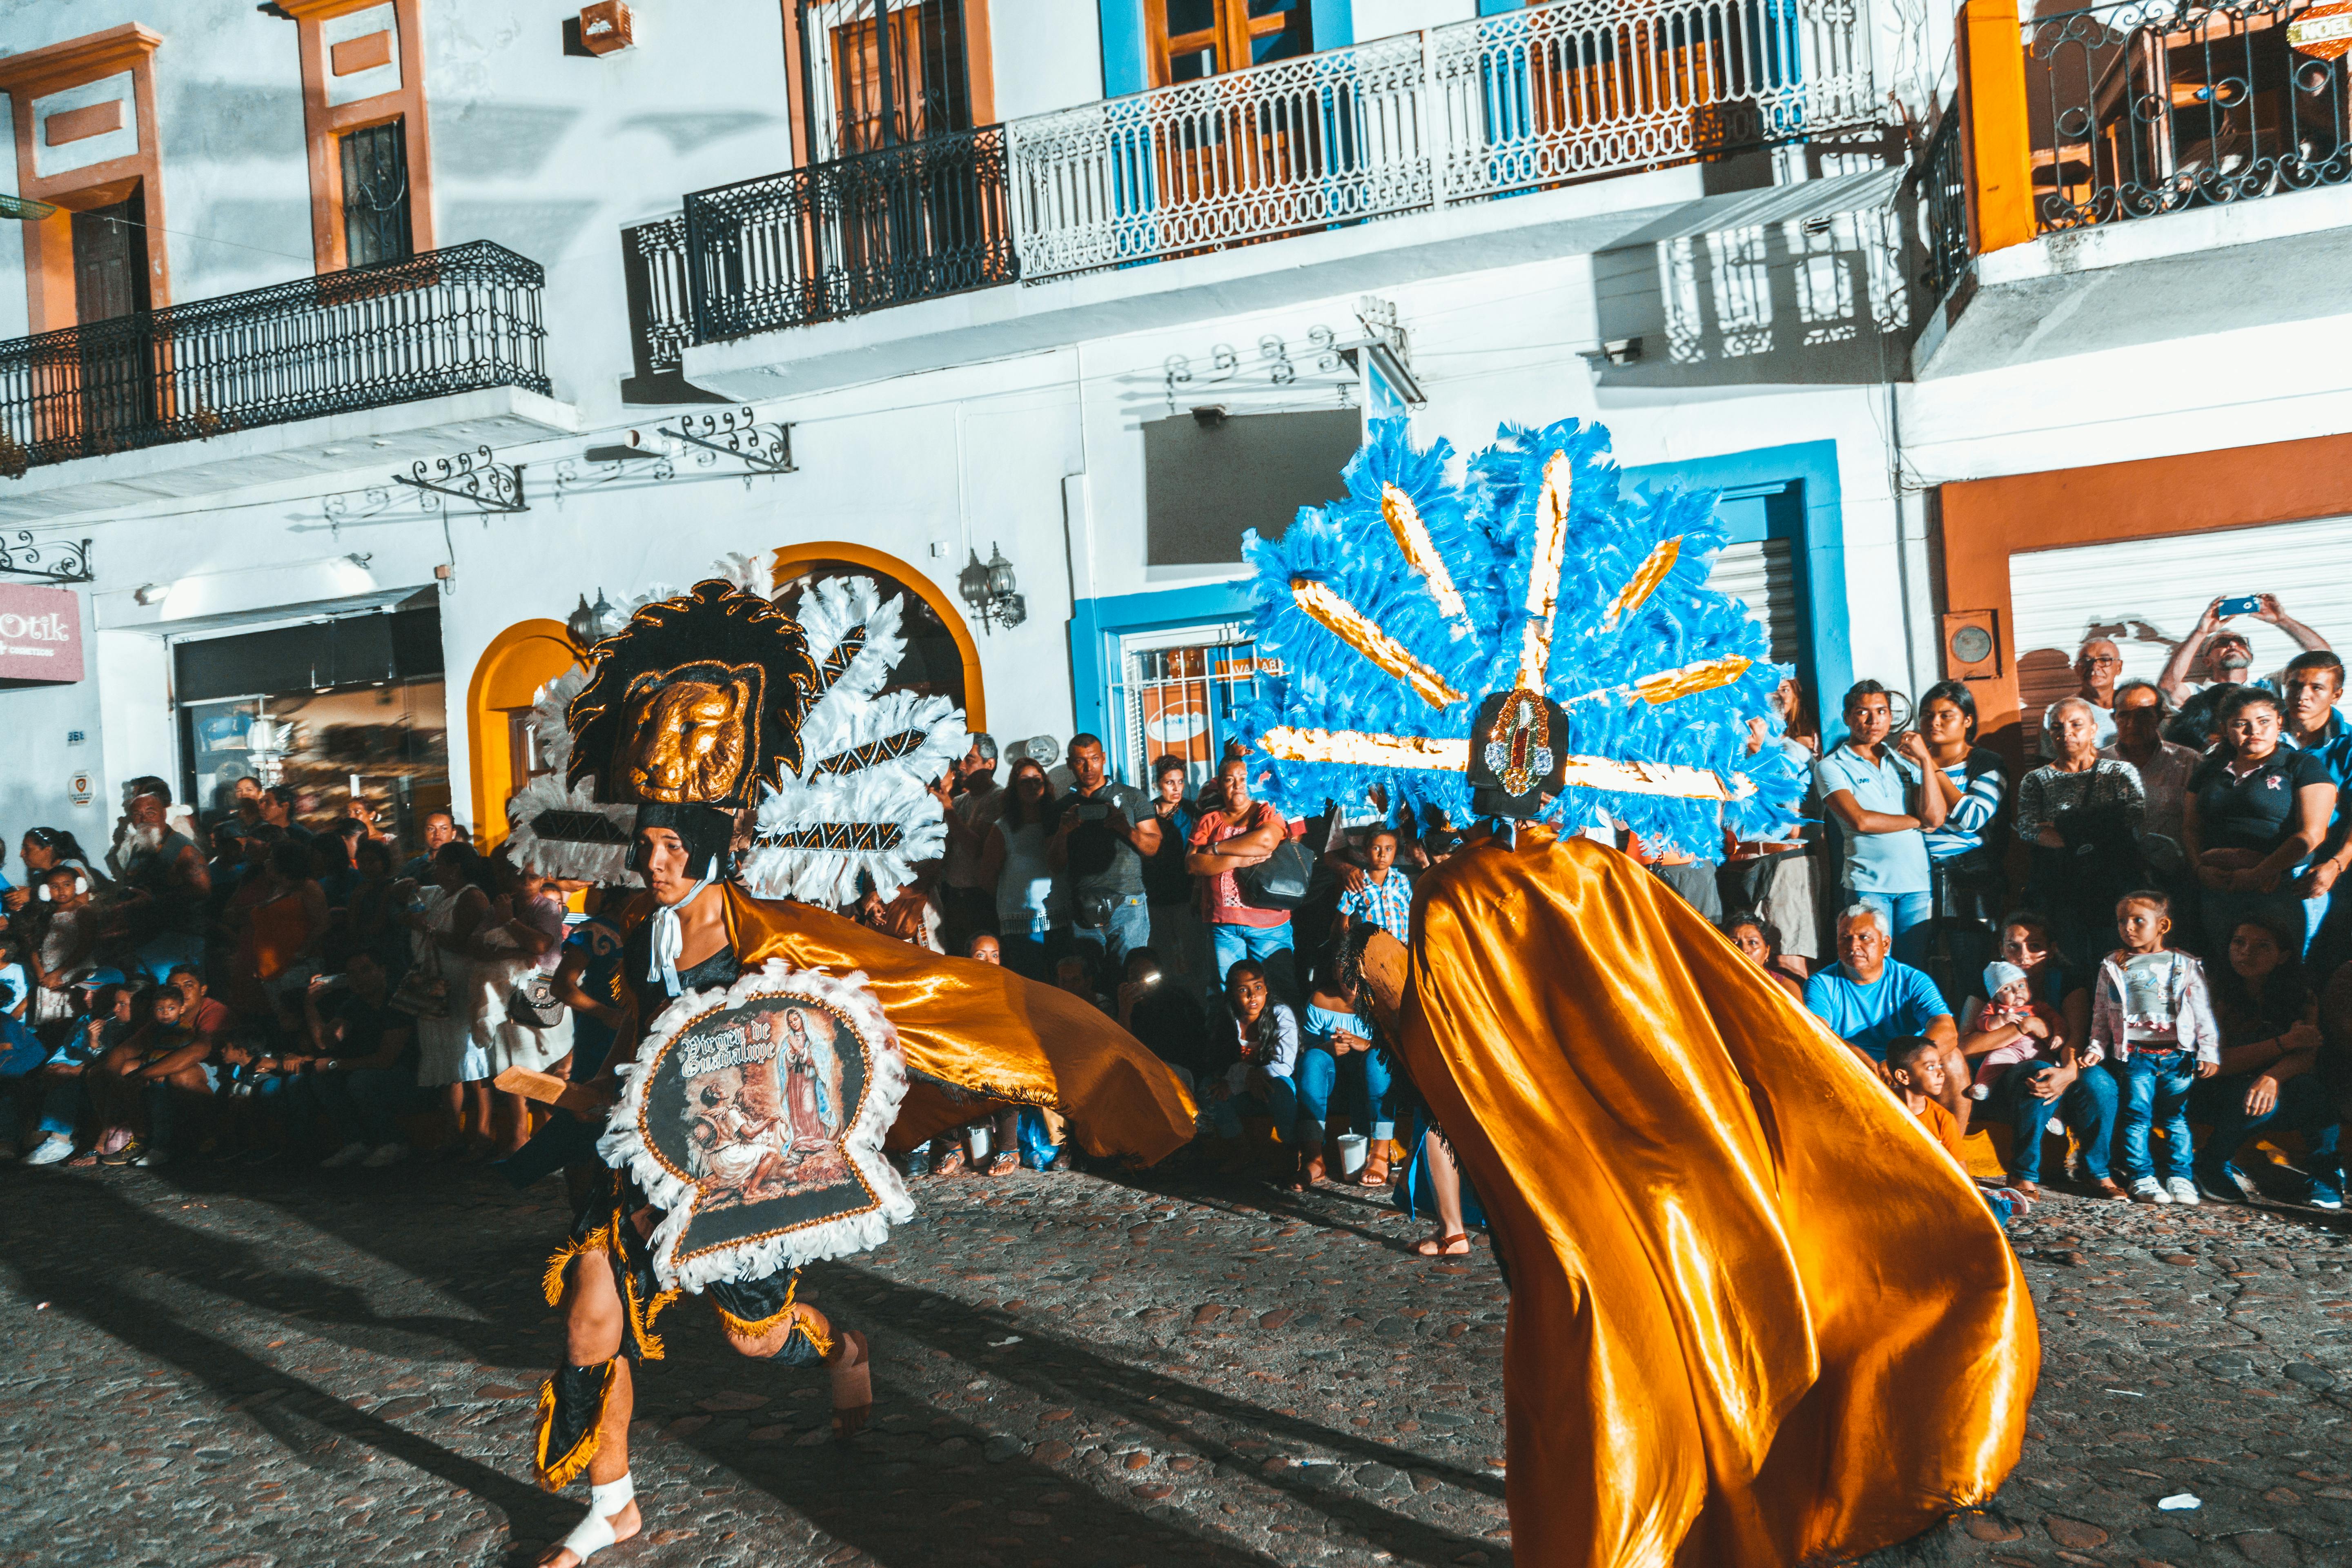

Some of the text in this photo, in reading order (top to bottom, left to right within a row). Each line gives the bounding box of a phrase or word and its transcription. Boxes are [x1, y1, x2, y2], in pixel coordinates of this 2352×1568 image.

[2301, 17, 2352, 40] NOEL
[0, 613, 69, 641] Otik
[9, 646, 55, 657] COSMETICOS
[681, 1020, 771, 1058] Virgen de
[682, 1041, 776, 1078] Guadalupe
